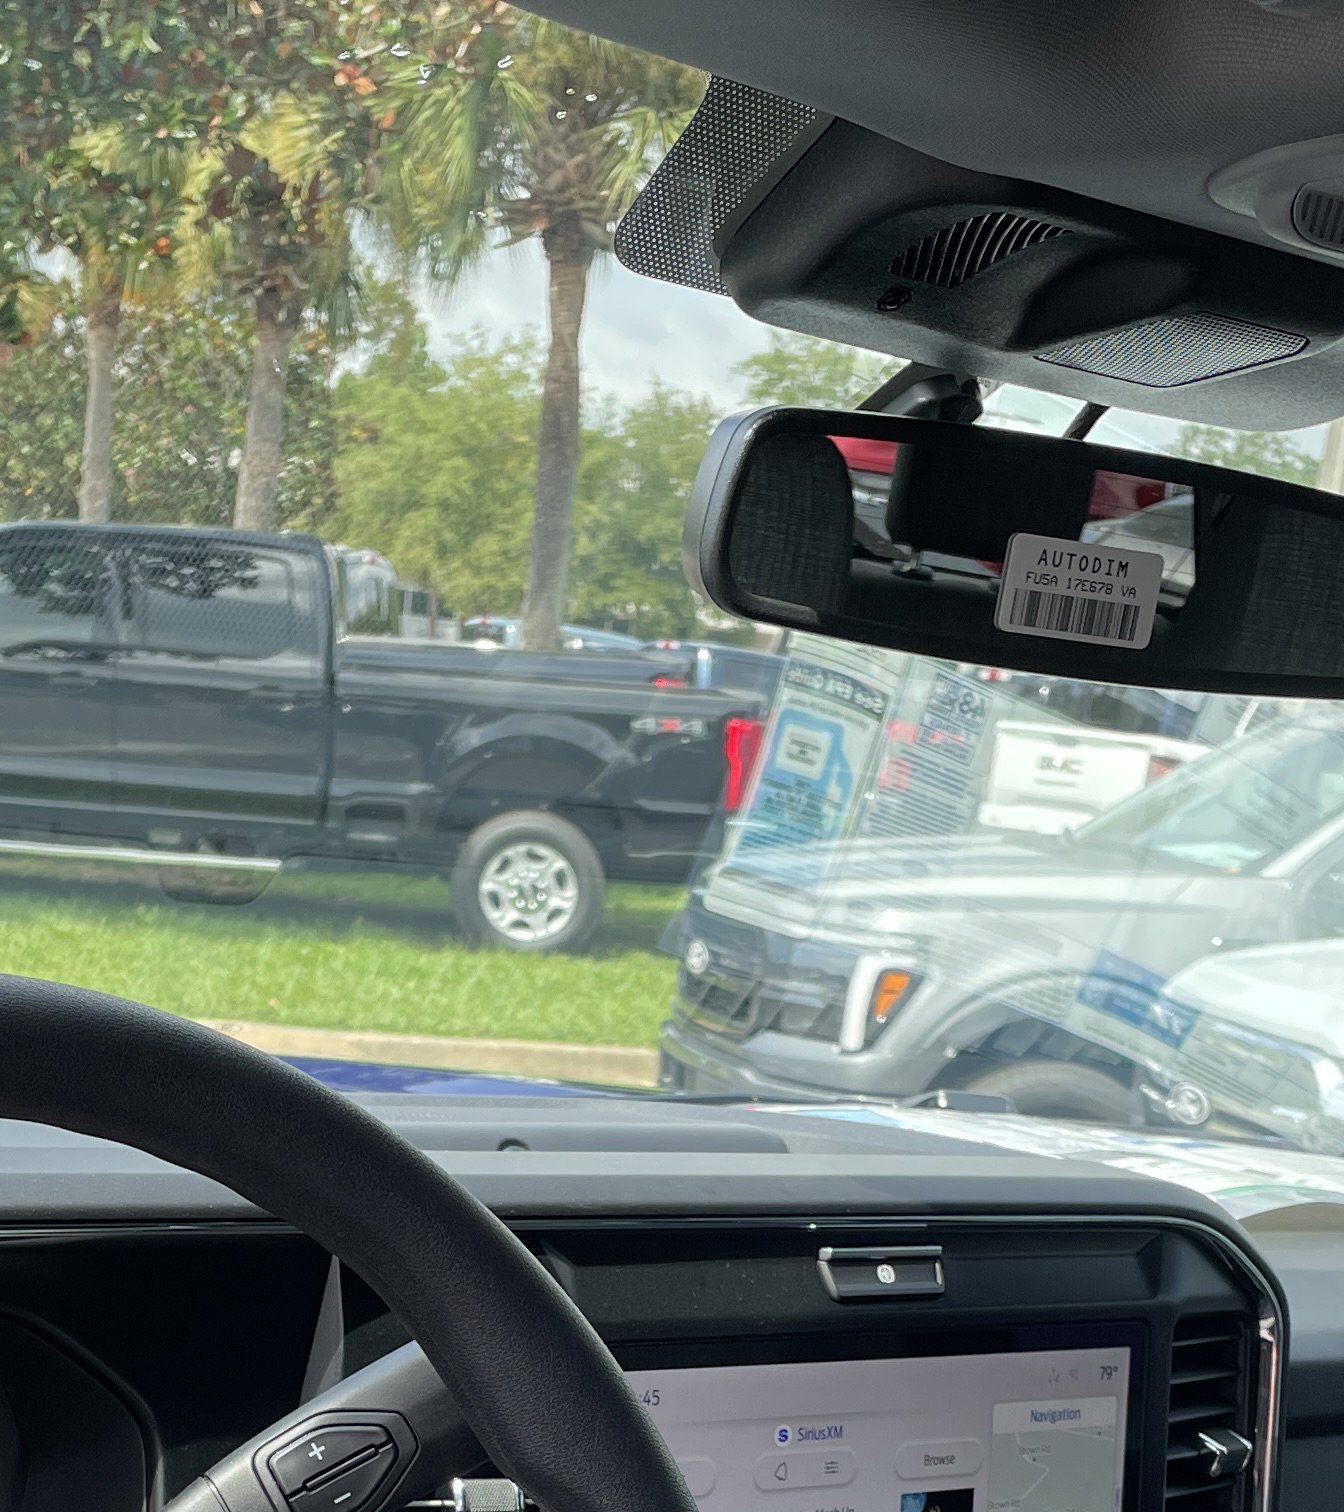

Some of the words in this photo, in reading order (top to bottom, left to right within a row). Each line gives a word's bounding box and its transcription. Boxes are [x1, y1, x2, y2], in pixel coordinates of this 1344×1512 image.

[1037, 548, 1130, 579] AUTODIM
[1065, 577, 1114, 596] 17E678
[1120, 585, 1137, 599] VA
[1030, 1408, 1081, 1424] Navigation
[797, 1426, 844, 1442] SiriusXM
[923, 1454, 956, 1467] Browse
